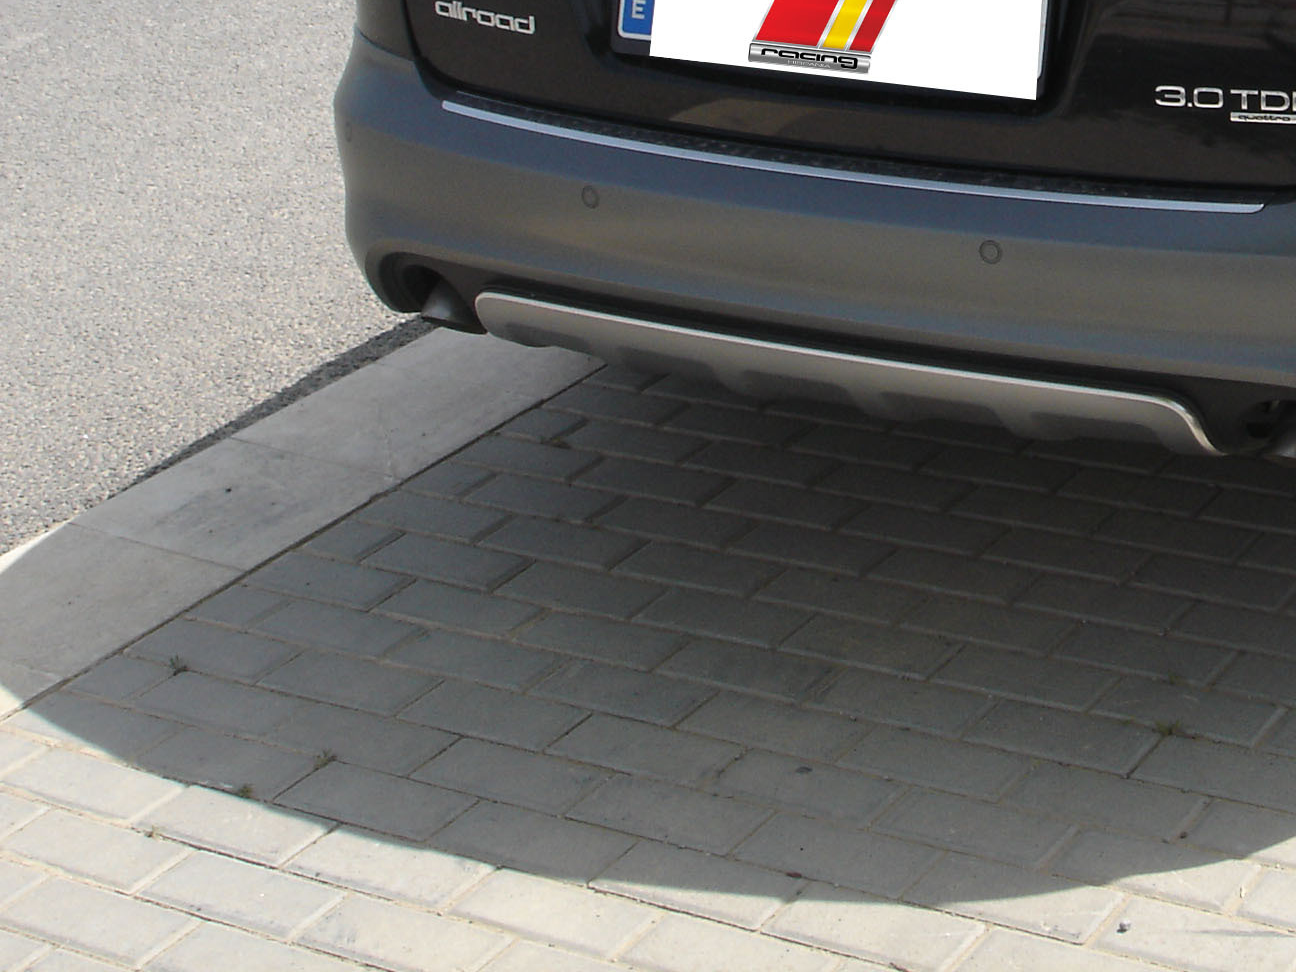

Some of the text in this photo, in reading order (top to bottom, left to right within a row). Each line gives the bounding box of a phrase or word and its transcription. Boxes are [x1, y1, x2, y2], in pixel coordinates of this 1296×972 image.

[435, 0, 535, 35] allroad
[1155, 85, 1224, 109] 3.0
[1238, 114, 1291, 122] quattro
